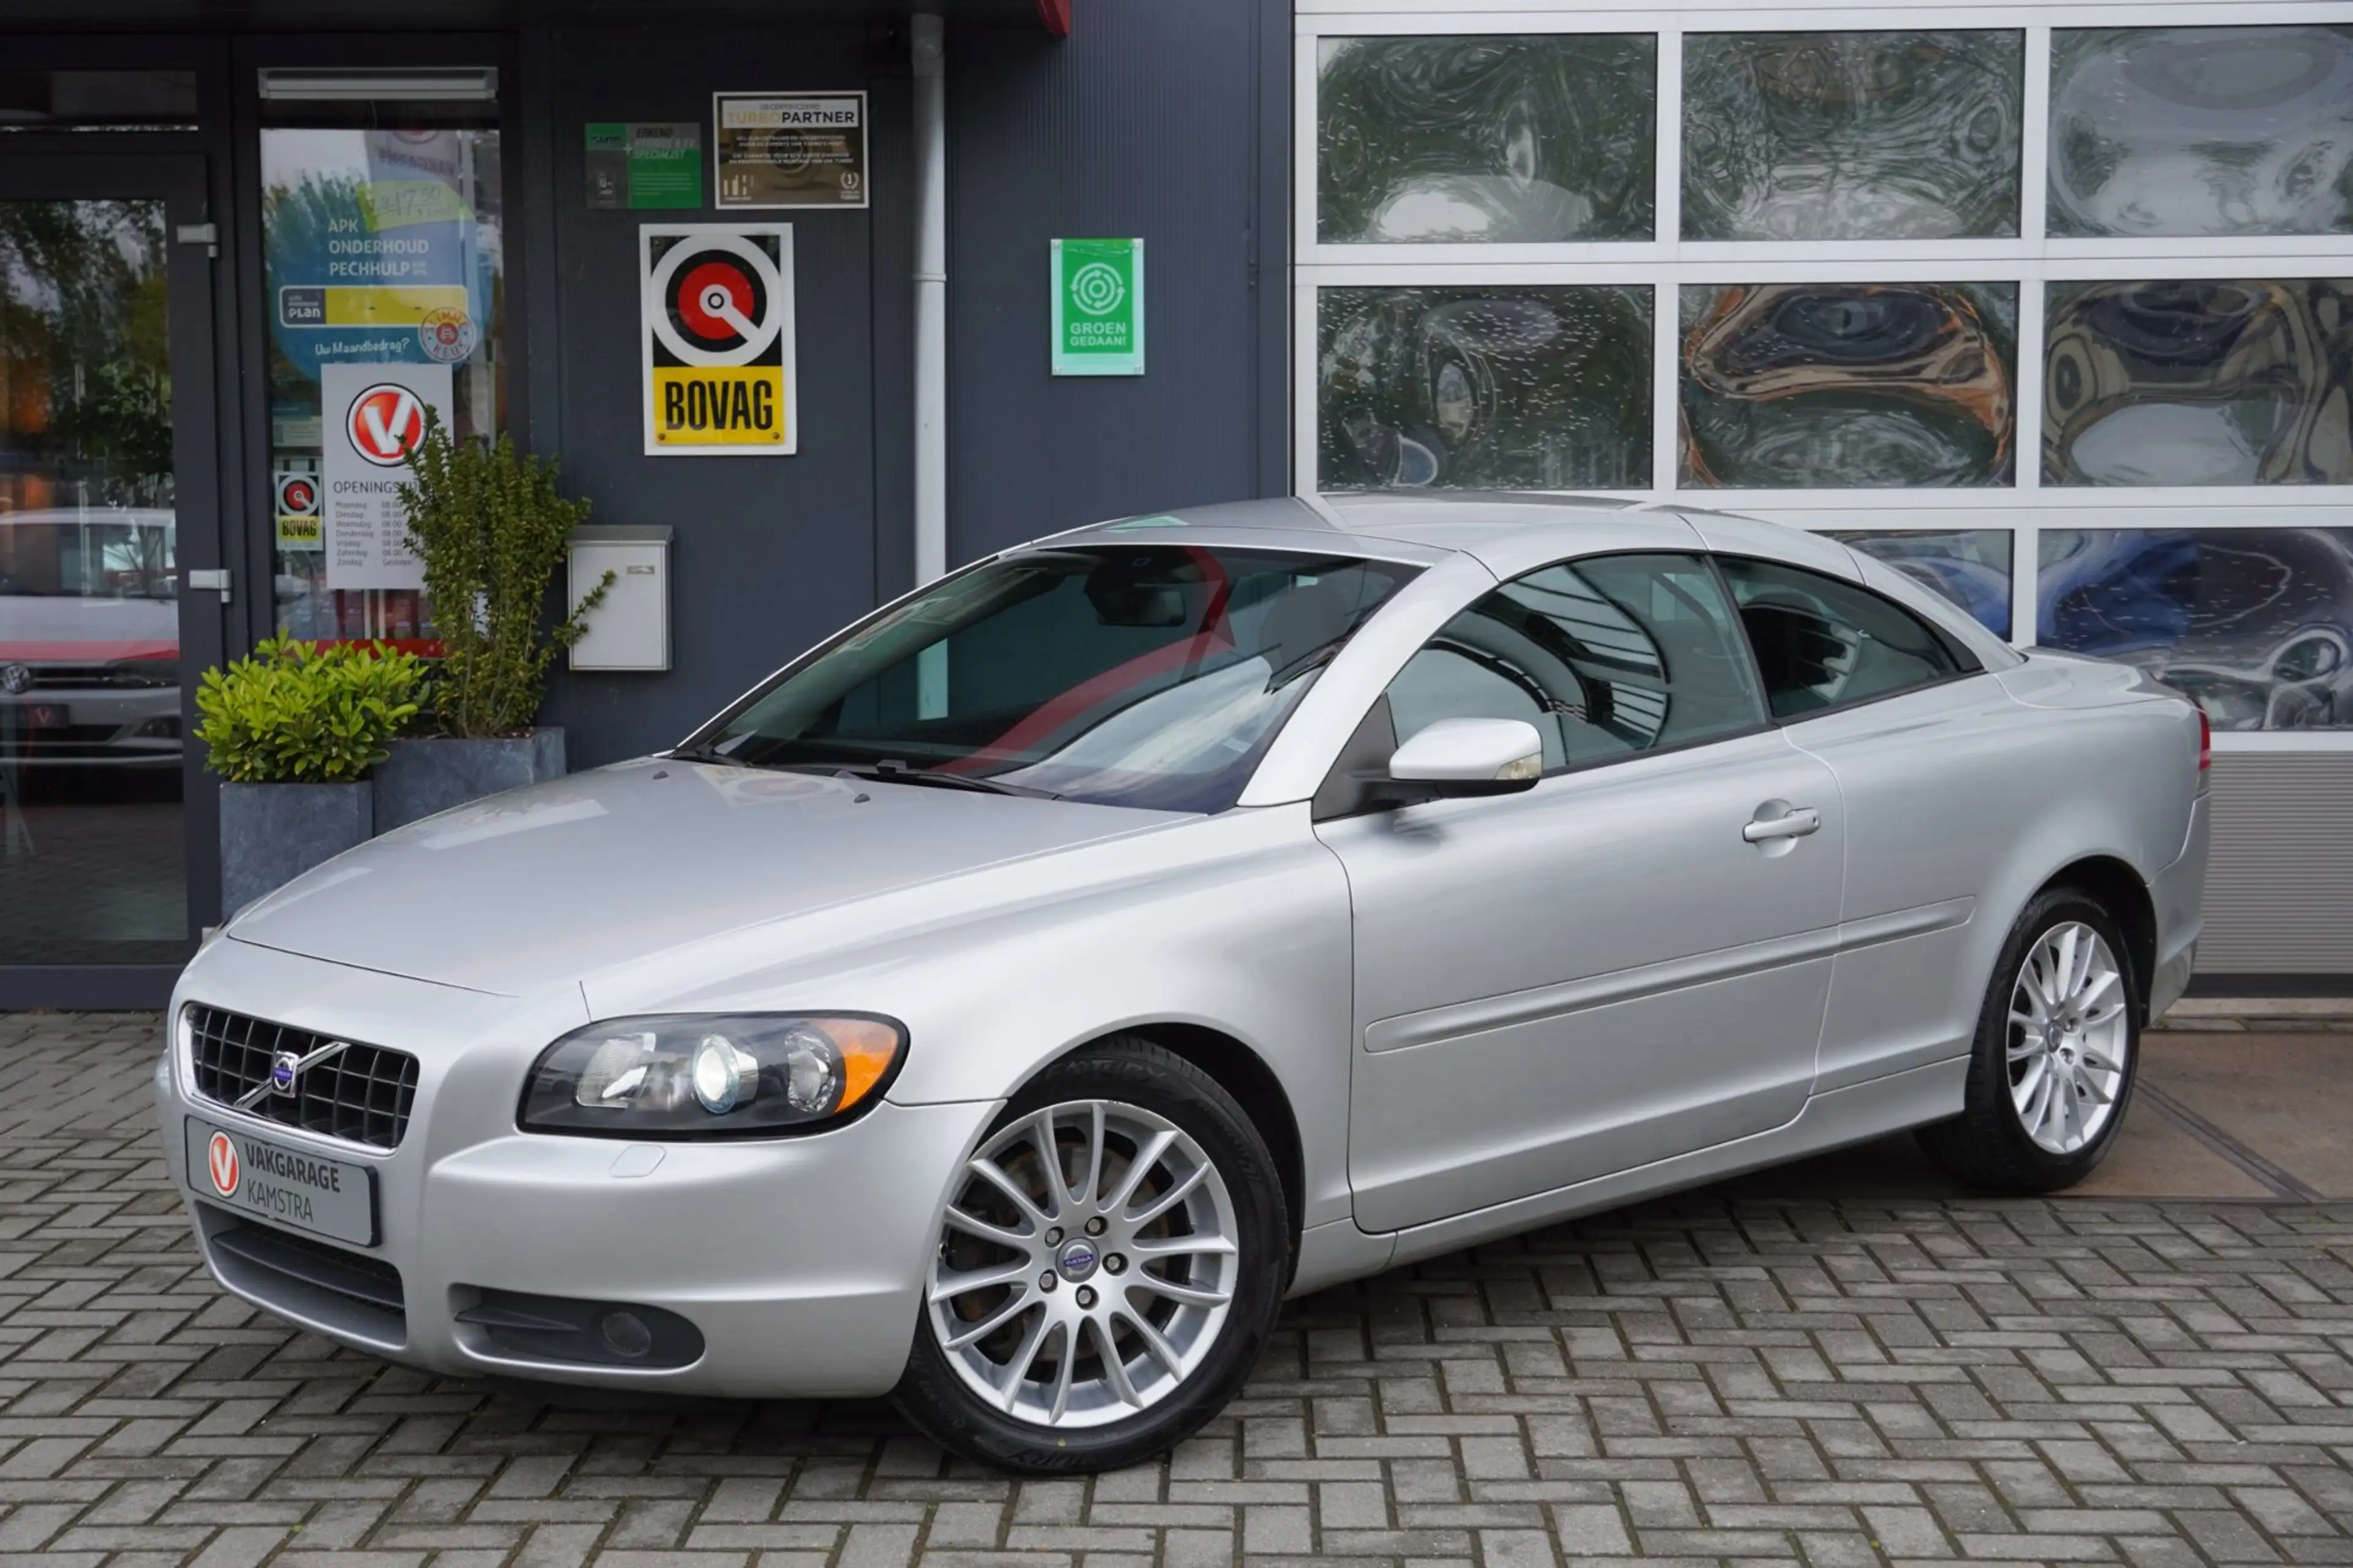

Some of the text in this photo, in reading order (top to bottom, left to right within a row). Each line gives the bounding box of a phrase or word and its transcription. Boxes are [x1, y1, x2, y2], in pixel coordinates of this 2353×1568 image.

[328, 219, 358, 233] APK
[329, 240, 429, 254] ONDERHOUD
[329, 261, 411, 276] PECHHULP
[1070, 322, 1126, 335] GROEN
[315, 337, 410, 355] Uw Maandbedrag?
[1070, 336, 1126, 346] GEDAAN!
[665, 380, 773, 431] BOVAG
[282, 520, 317, 536] BOVAG
[245, 1143, 341, 1194] VAKGARAGE
[248, 1178, 314, 1223] KAMSTRA
